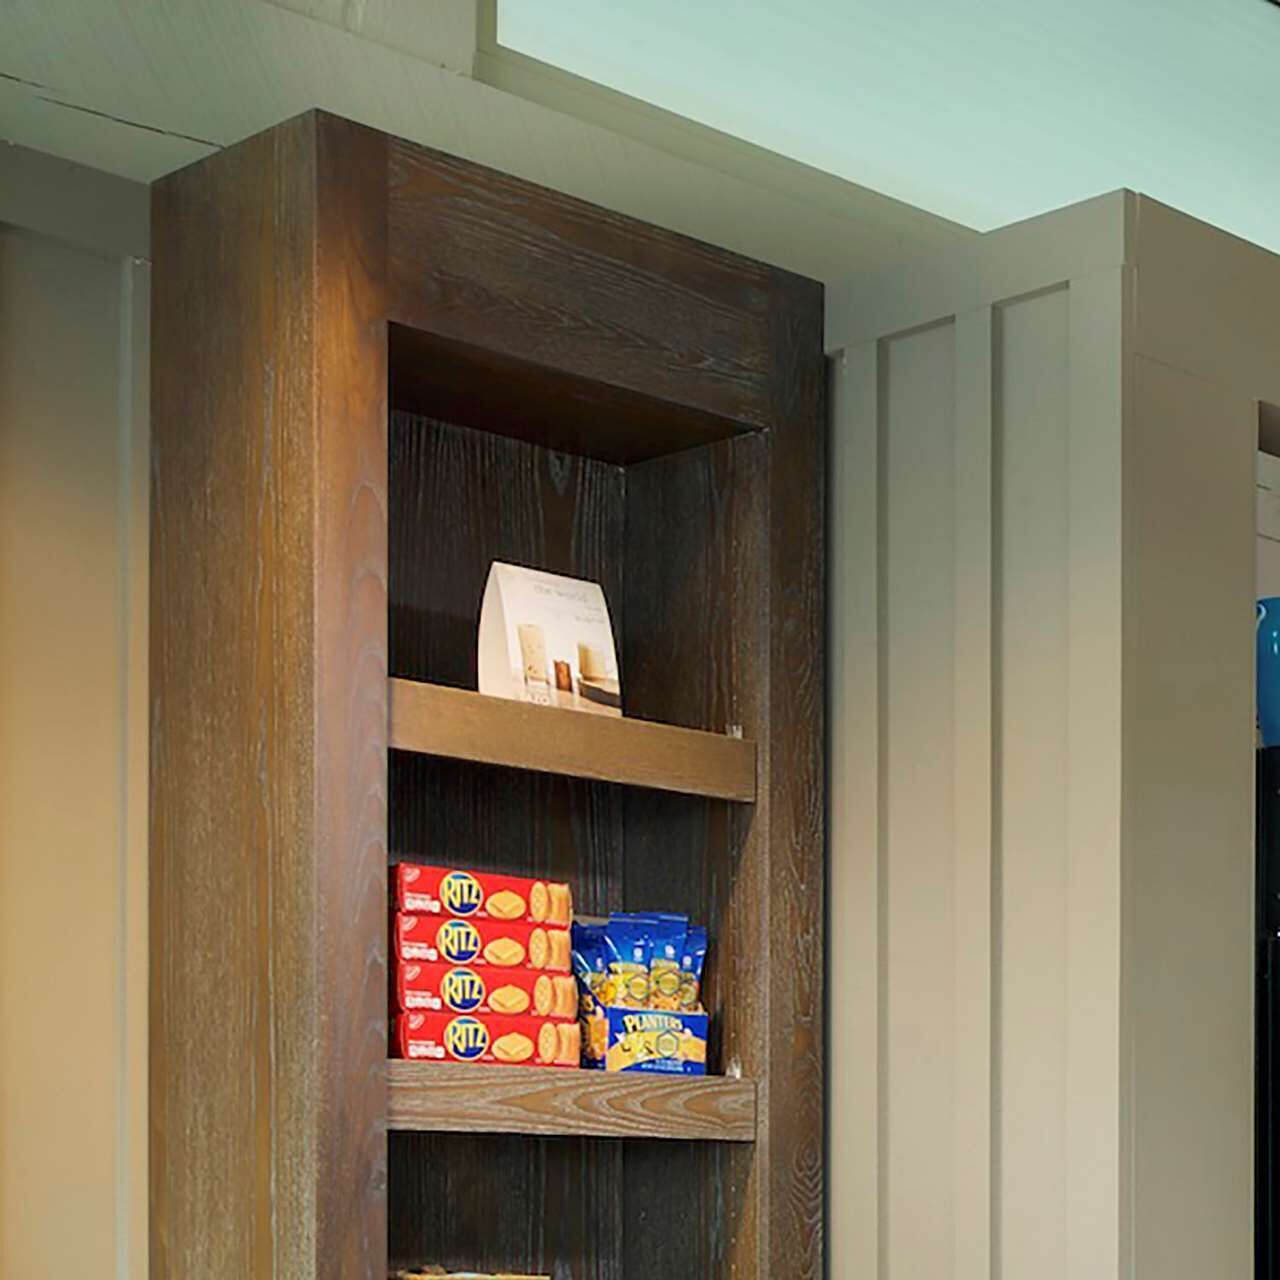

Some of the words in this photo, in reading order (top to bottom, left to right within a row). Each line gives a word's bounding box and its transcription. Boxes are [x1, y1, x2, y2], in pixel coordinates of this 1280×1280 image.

[445, 876, 479, 908] RITZ
[442, 925, 476, 956] RITZ
[446, 973, 482, 1004] RITZ
[449, 1020, 485, 1053] RITZ
